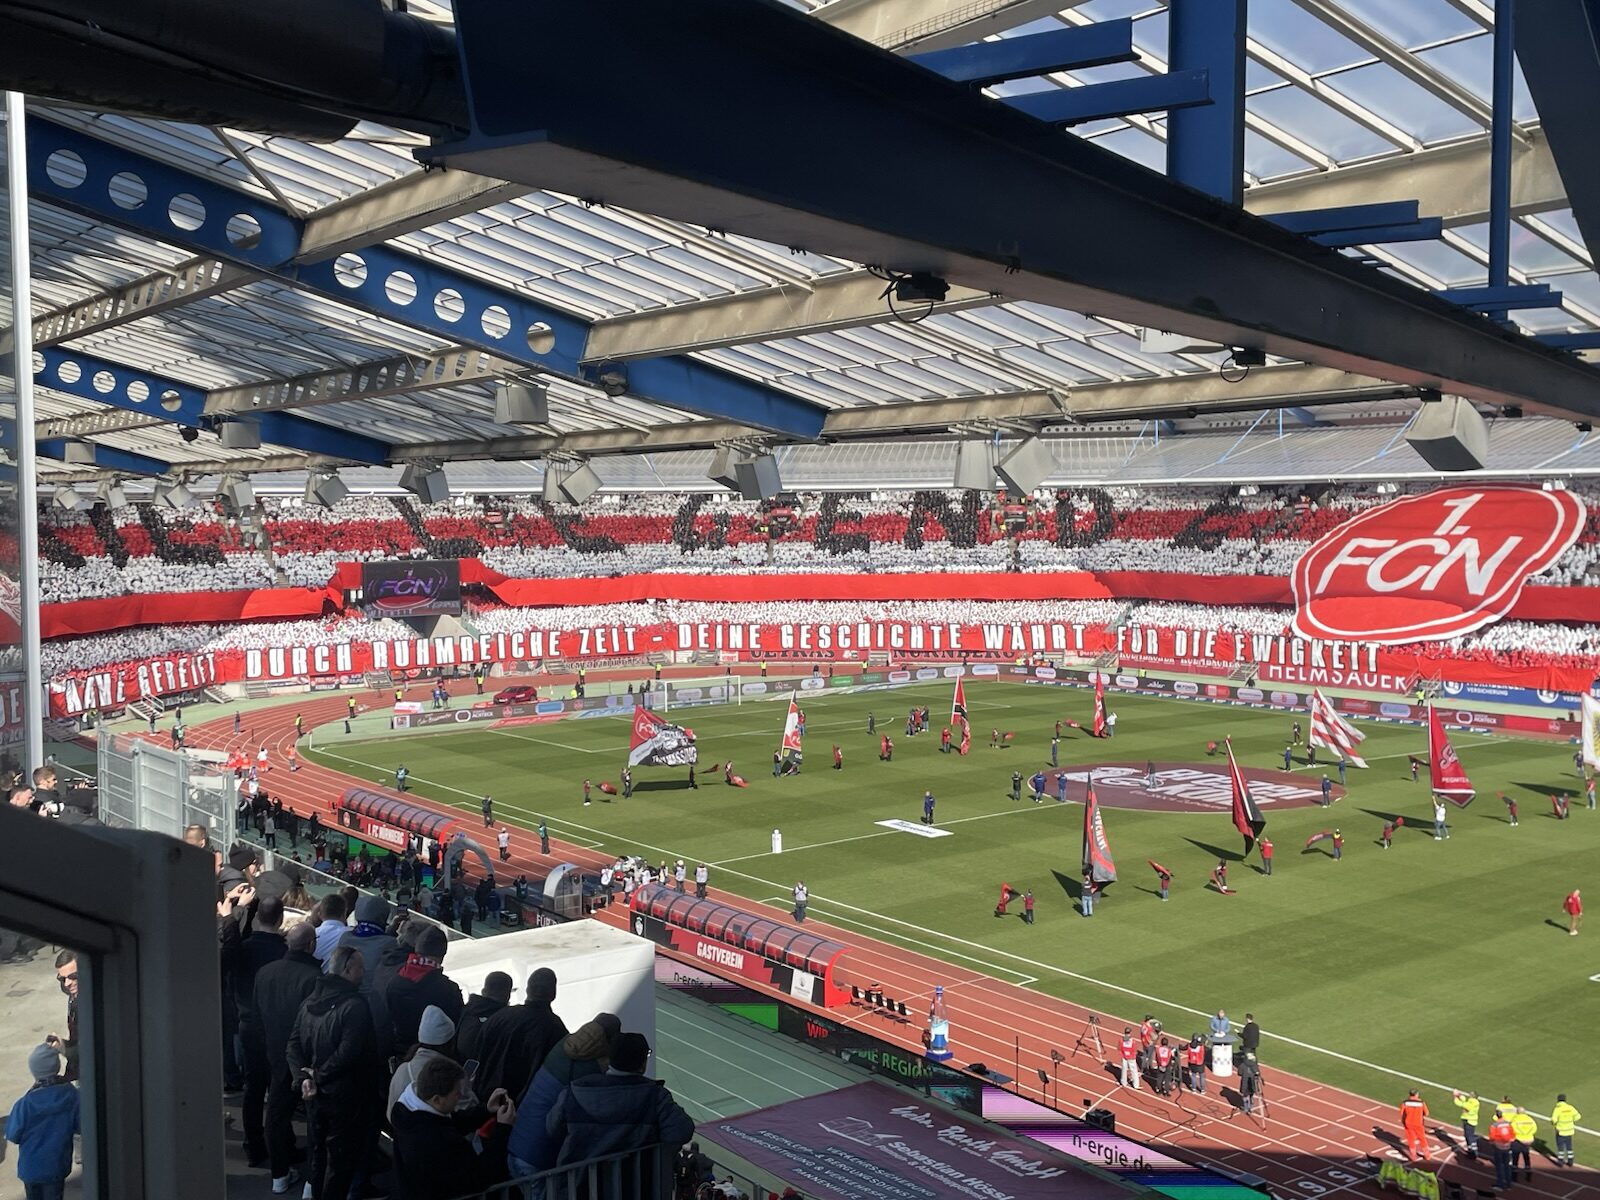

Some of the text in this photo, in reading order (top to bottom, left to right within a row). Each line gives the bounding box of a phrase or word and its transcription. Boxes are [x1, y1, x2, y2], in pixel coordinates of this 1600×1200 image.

[1434, 493, 1485, 535] 1.
[1315, 536, 1523, 596] FCN
[246, 643, 352, 678] DURCH
[372, 630, 561, 669] RUHMREICHE
[579, 627, 636, 654] ZEIT
[678, 623, 762, 649] DEINE
[780, 622, 962, 649] GESCHICHTE
[982, 621, 1085, 651] WÄHRT
[1117, 624, 1159, 655] FÜR
[1175, 630, 1218, 657] DIE
[1235, 634, 1381, 673] EWIGKEIT
[697, 941, 744, 970] GASTVEREIN
[889, 1141, 967, 1179] Sebastian
